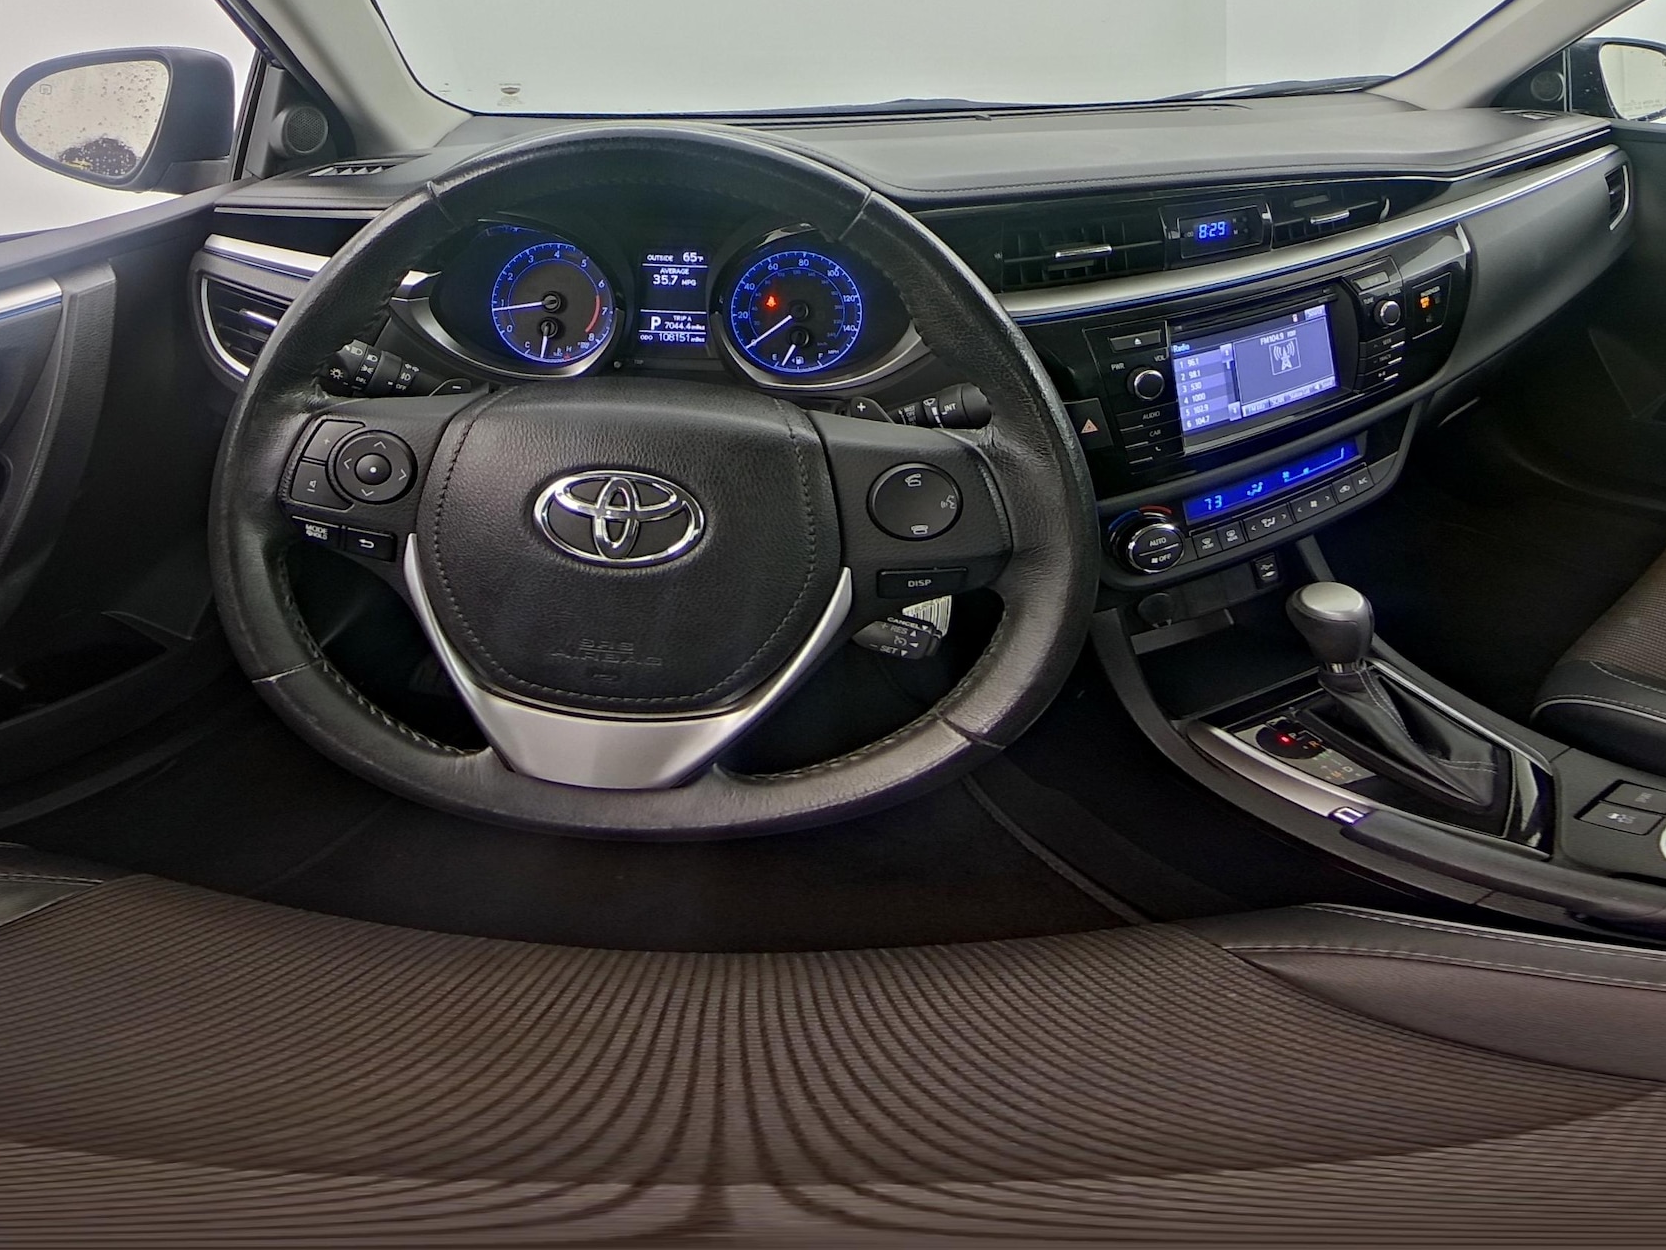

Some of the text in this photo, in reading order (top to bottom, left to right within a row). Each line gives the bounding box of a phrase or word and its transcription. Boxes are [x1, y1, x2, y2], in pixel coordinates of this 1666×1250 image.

[1199, 221, 1225, 239] 8:29
[647, 254, 673, 262] OUTSIDE
[653, 274, 678, 285] 35.7
[737, 311, 749, 319] 20
[651, 316, 661, 330] P
[1173, 343, 1190, 353] Radio
[1143, 411, 1160, 420] AUDIO
[1149, 537, 1167, 547] AUTO
[1158, 554, 1171, 562] OFF
[907, 579, 932, 588] DISP
[886, 616, 920, 629] CANCEL
[890, 625, 909, 635] RES
[880, 644, 898, 654] SET
